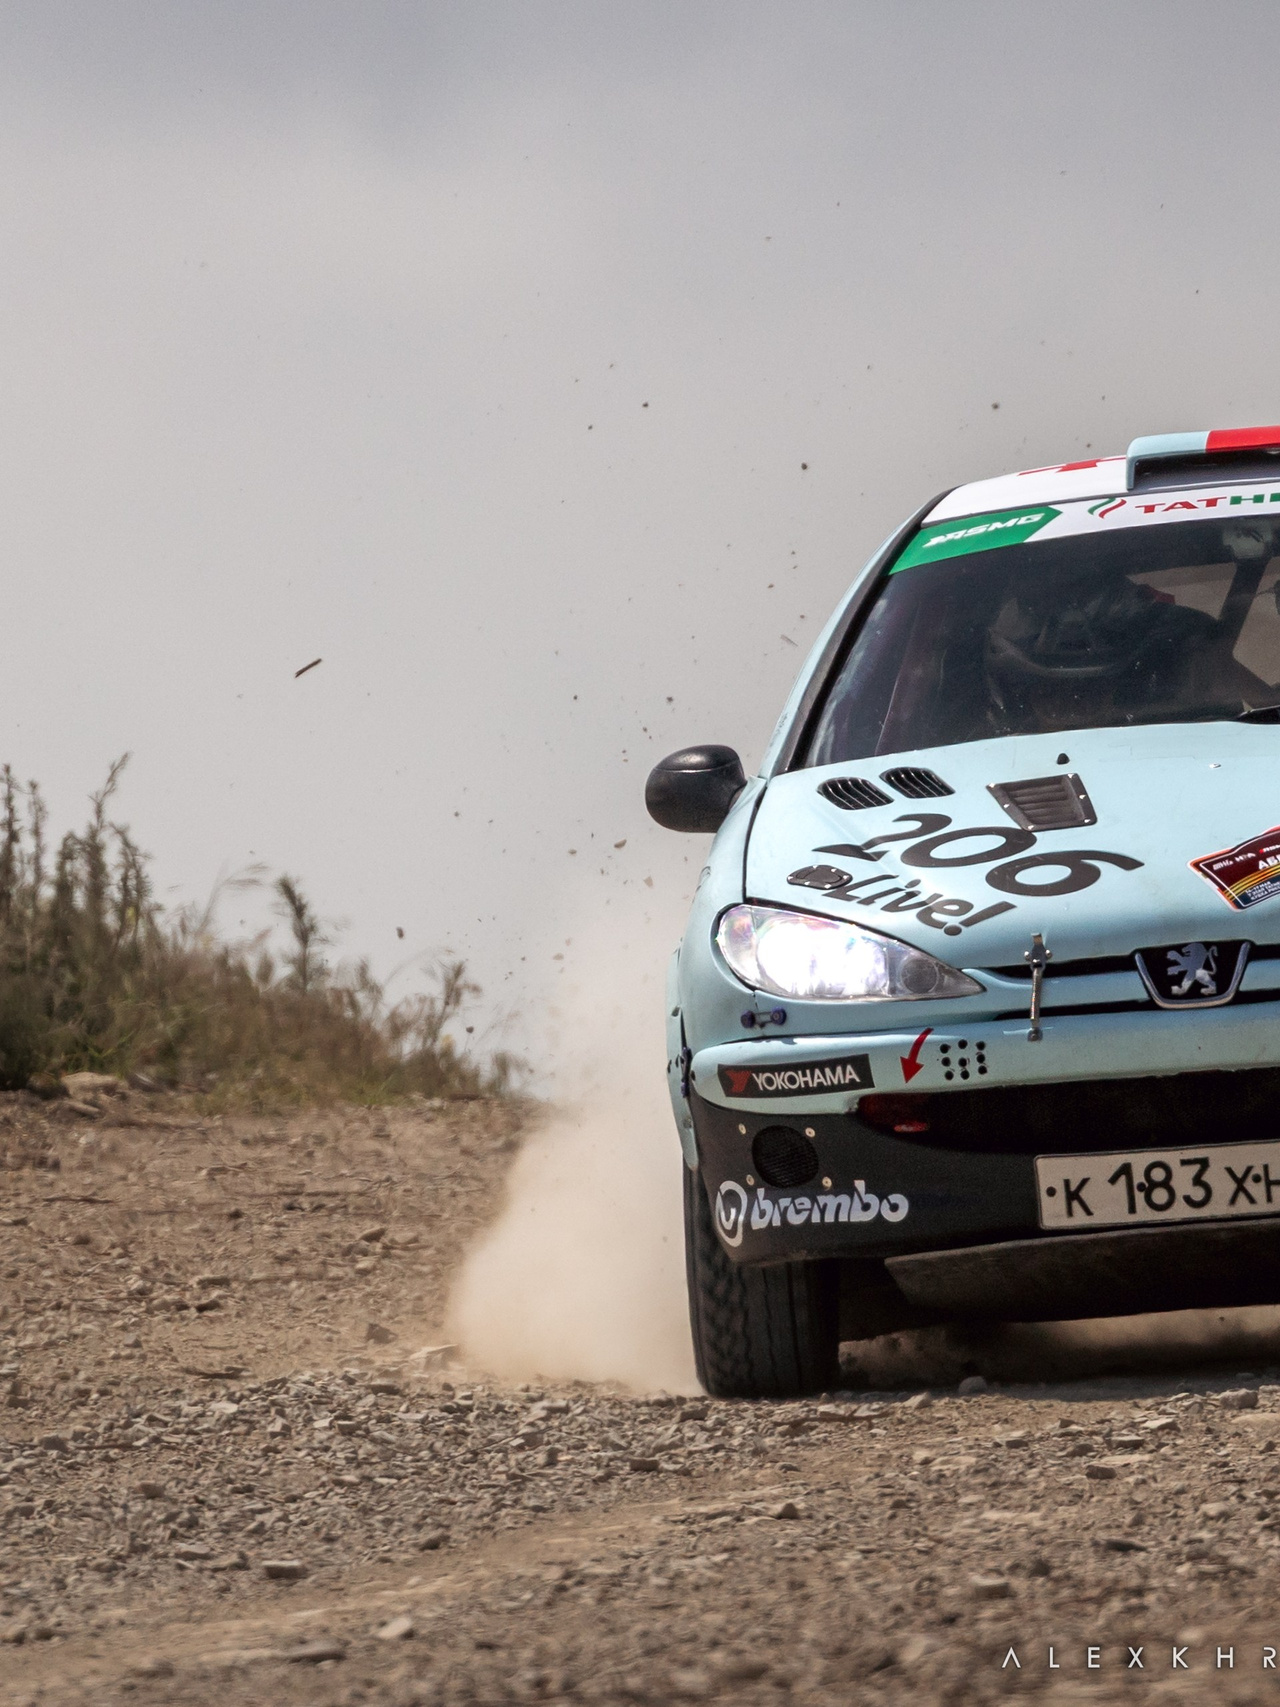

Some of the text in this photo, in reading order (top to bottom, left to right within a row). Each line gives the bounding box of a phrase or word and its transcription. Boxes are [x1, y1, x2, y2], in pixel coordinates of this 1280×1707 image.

[811, 812, 1145, 897] 206
[821, 874, 1017, 936] Live!
[752, 1065, 861, 1091] YOKOHAMA
[751, 1179, 909, 1230] brembo
[1108, 1157, 1213, 1214] 183
